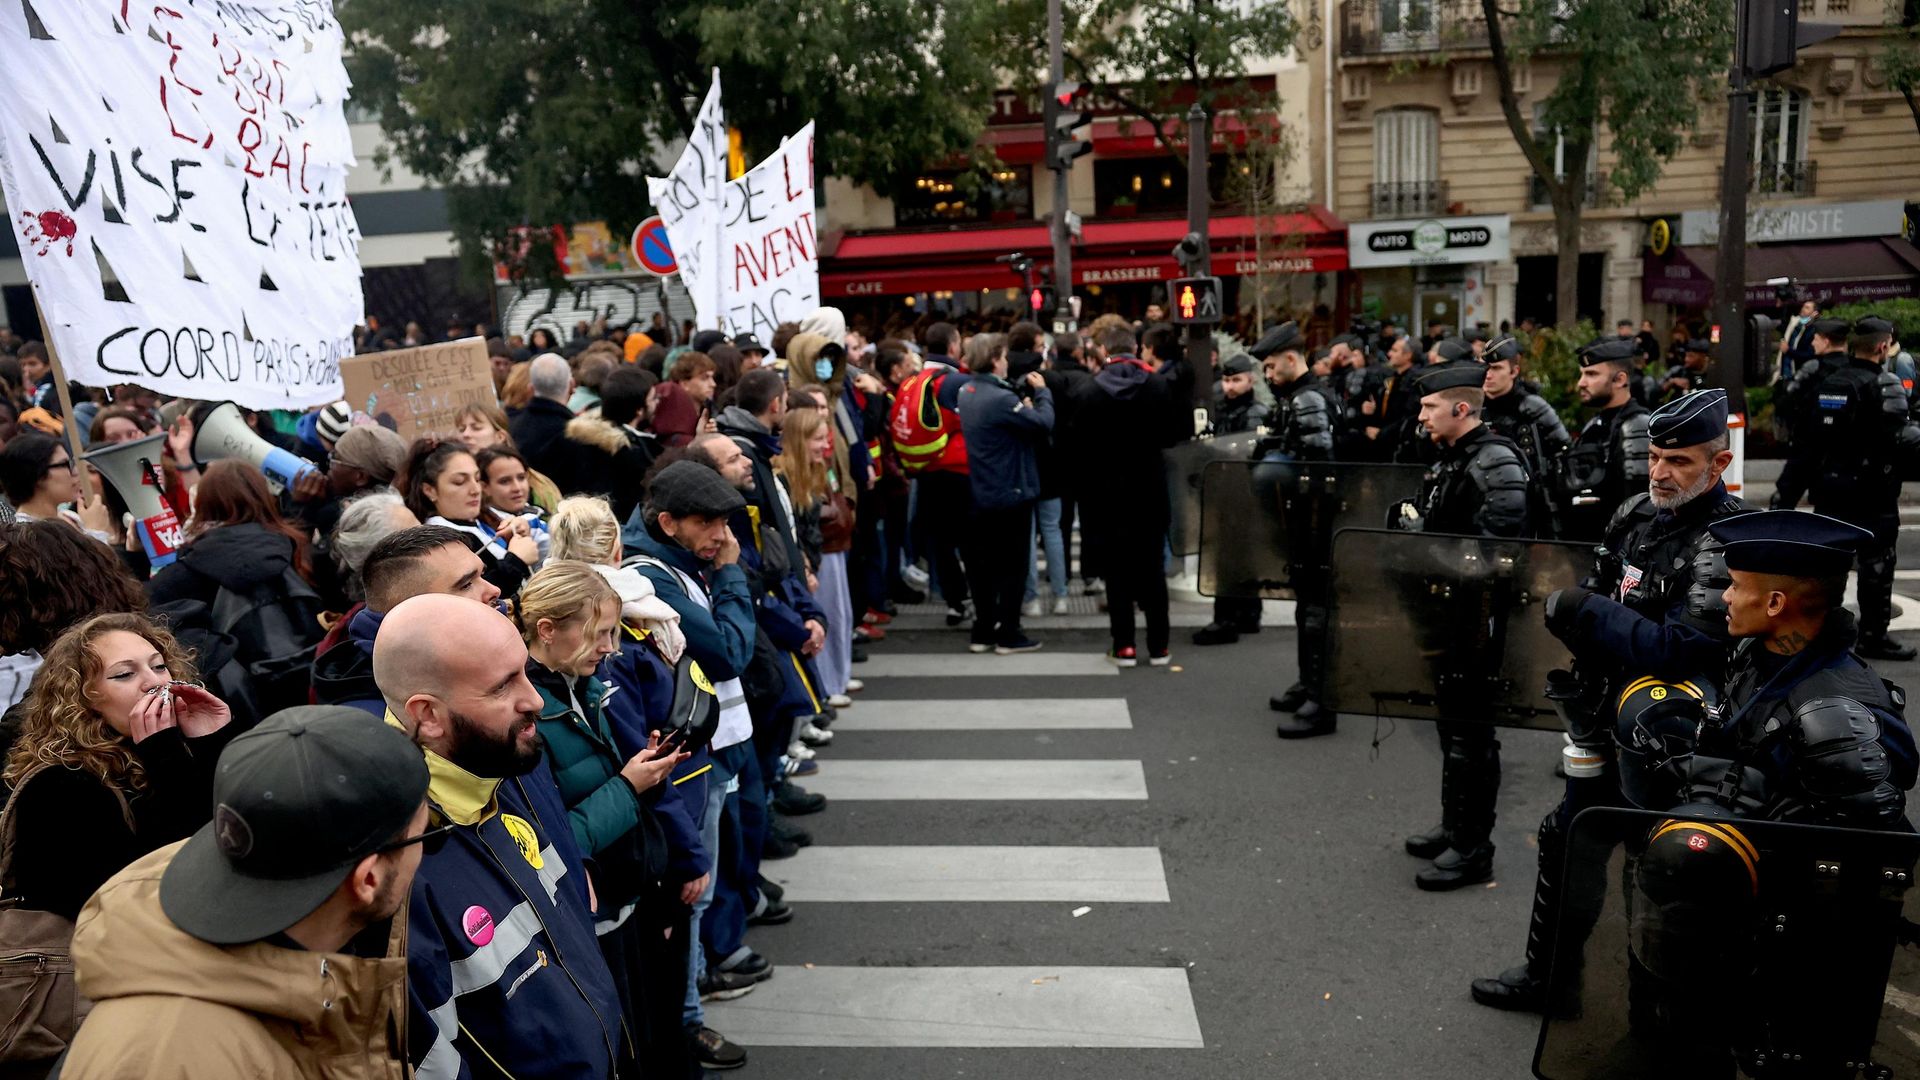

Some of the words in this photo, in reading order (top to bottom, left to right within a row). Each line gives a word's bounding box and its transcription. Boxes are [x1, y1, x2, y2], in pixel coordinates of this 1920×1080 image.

[1372, 234, 1407, 248] AUTO
[1450, 230, 1487, 244] MOTO
[1082, 266, 1161, 283] BRASSERIE
[846, 281, 883, 295] CAFE
[97, 326, 241, 382] COORD
[1690, 836, 1707, 848] 33
